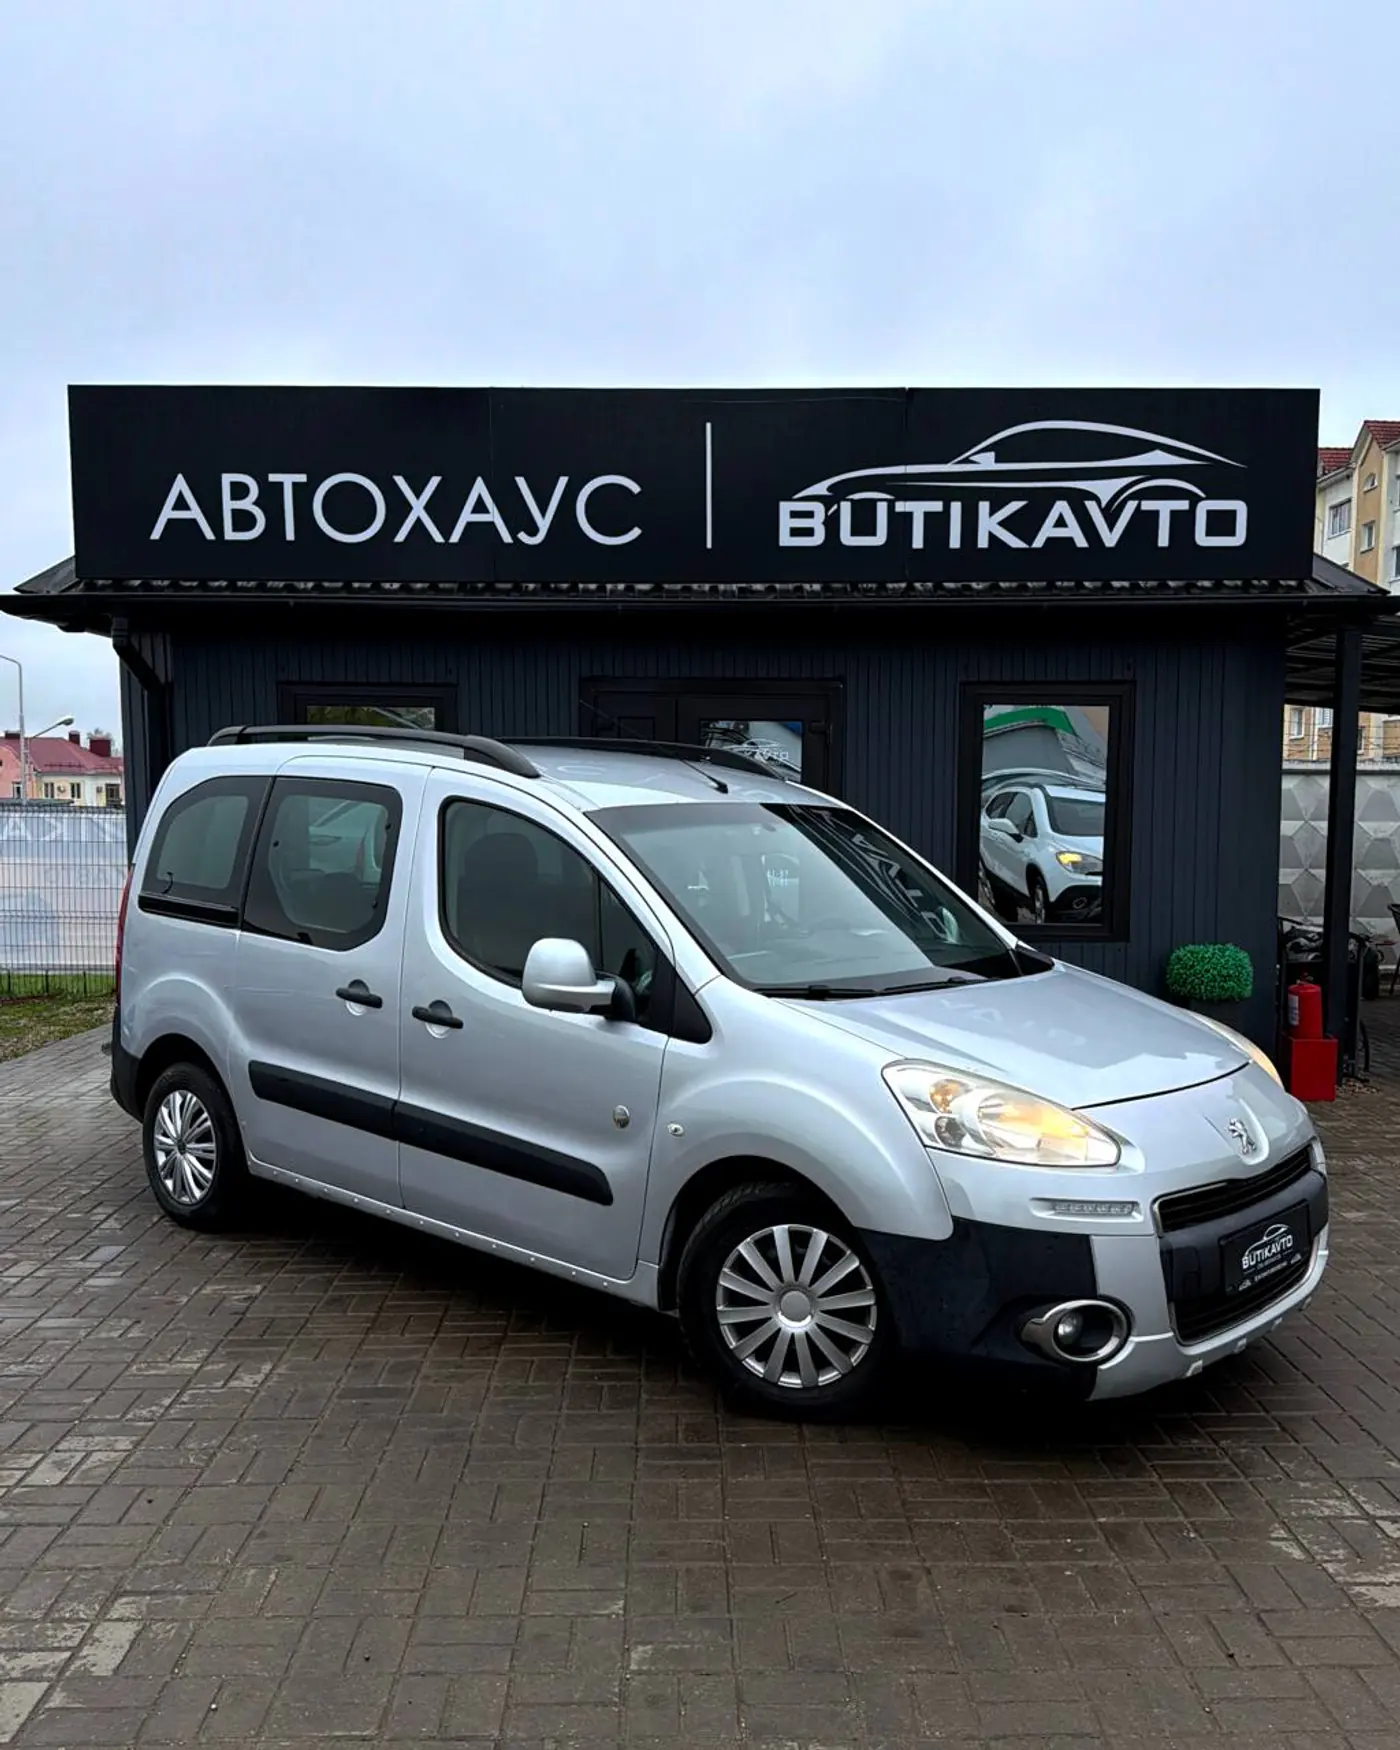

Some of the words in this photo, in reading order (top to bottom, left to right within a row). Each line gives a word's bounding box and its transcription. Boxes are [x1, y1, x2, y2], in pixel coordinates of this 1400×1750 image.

[150, 472, 643, 546] АВТОХАУС
[778, 500, 1248, 550] BUTIKAVTO
[1242, 1235, 1293, 1269] BUTIKAVTO
